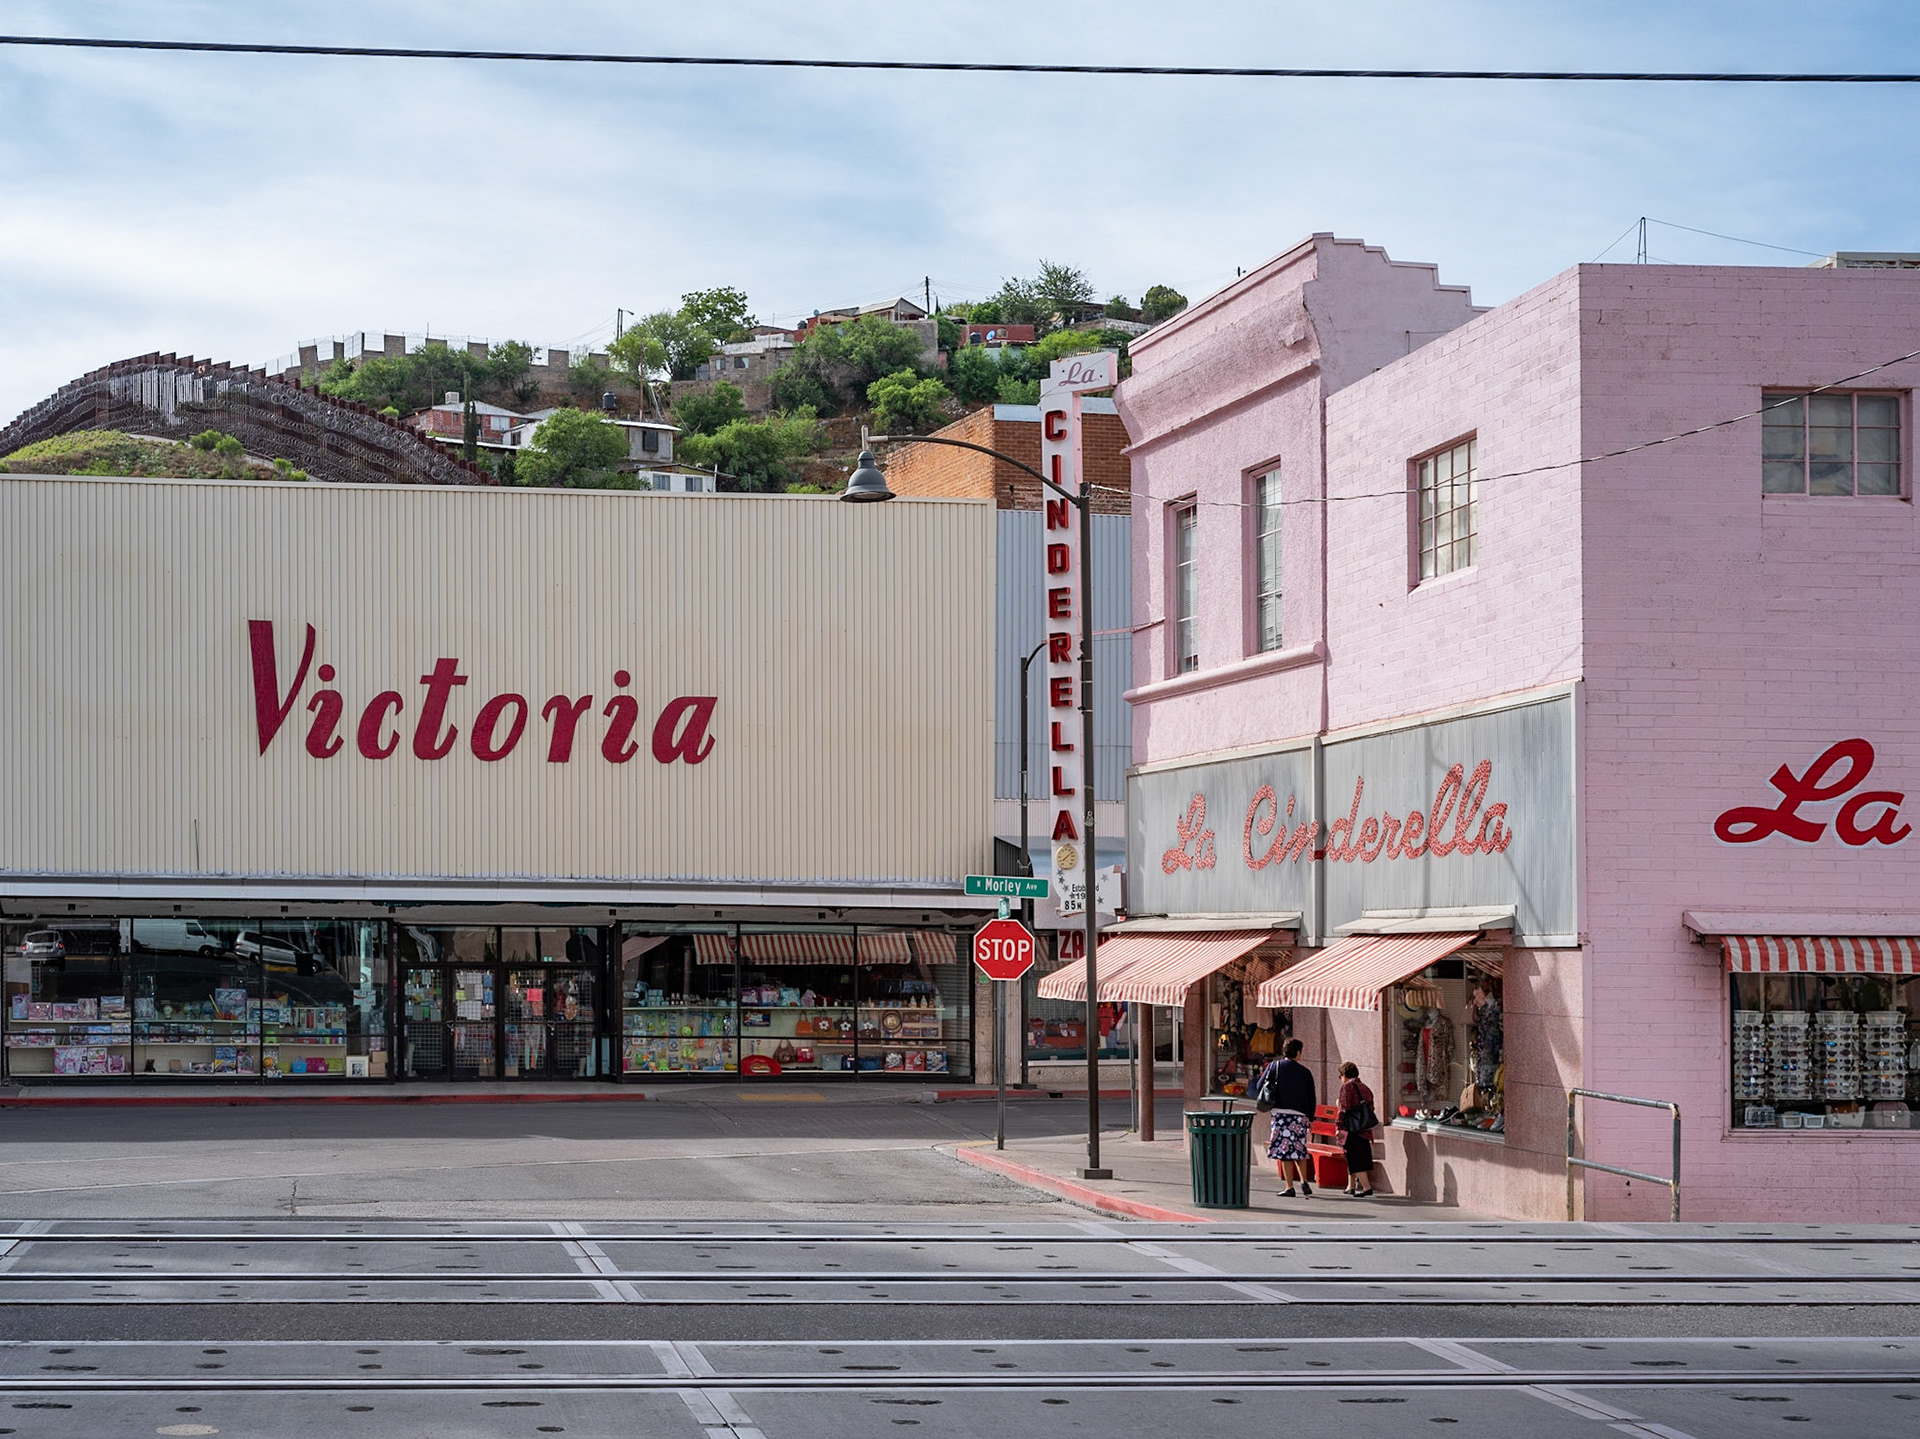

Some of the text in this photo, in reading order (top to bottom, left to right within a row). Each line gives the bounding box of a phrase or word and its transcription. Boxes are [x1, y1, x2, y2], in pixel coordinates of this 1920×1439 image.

[1059, 362, 1097, 386] La
[1044, 409, 1079, 841] CINDERELLA
[248, 619, 718, 765] Victoria
[1162, 759, 1513, 875] La Cinderella
[1714, 738, 1912, 847] La
[976, 880, 981, 888] N
[985, 877, 1021, 896] Morley
[978, 938, 1031, 962] STOP
